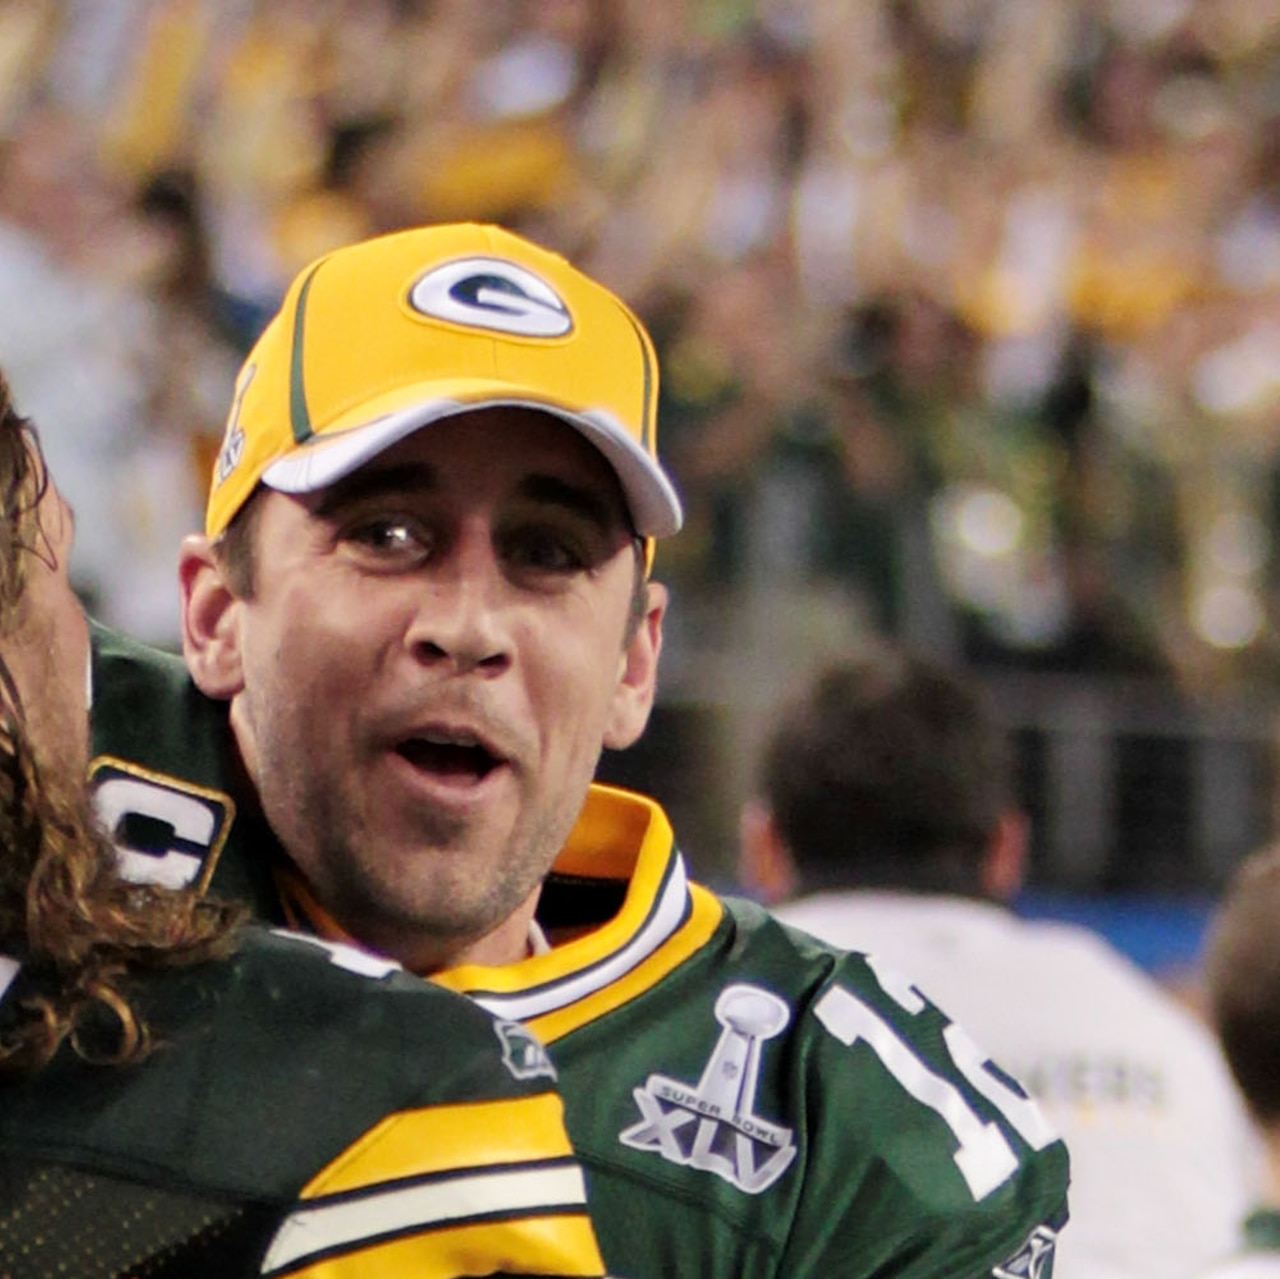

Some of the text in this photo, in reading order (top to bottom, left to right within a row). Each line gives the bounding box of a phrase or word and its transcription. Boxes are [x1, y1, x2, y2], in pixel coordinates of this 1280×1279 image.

[408, 256, 574, 338] G
[91, 779, 215, 890] C
[660, 1085, 780, 1144] SUPER BOWL
